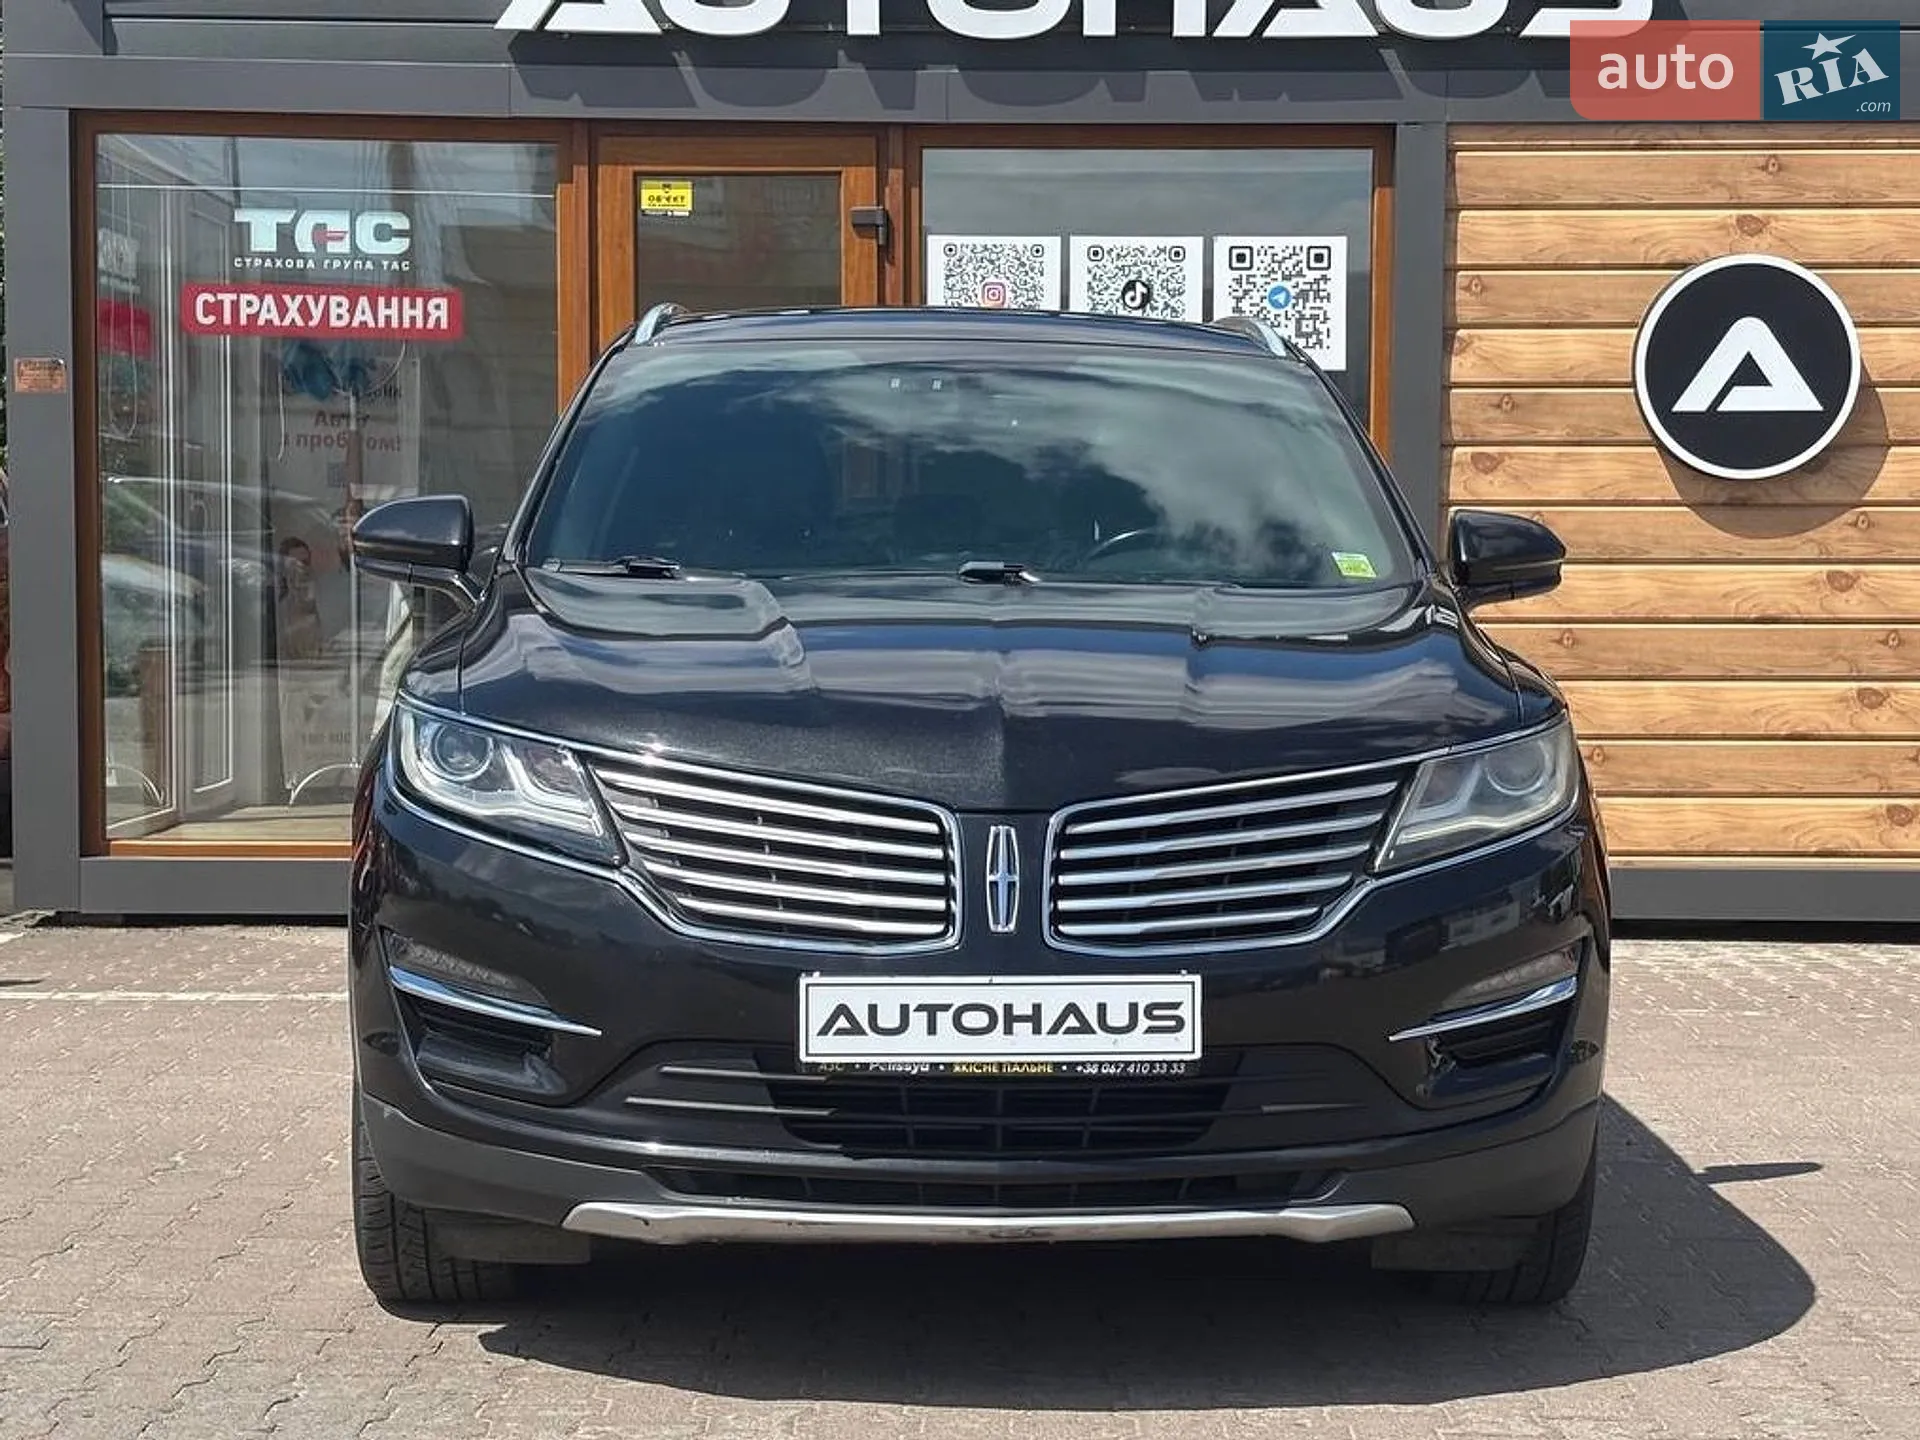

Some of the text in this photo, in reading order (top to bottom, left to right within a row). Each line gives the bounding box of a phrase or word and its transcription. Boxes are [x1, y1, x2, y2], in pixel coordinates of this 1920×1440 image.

[234, 209, 411, 255] ТАС
[233, 257, 411, 272] СТРАХОВА ГРУПА ТАС
[194, 292, 448, 330] СТРАХУВАННЯ
[816, 1001, 1187, 1036] AUTOHAUS
